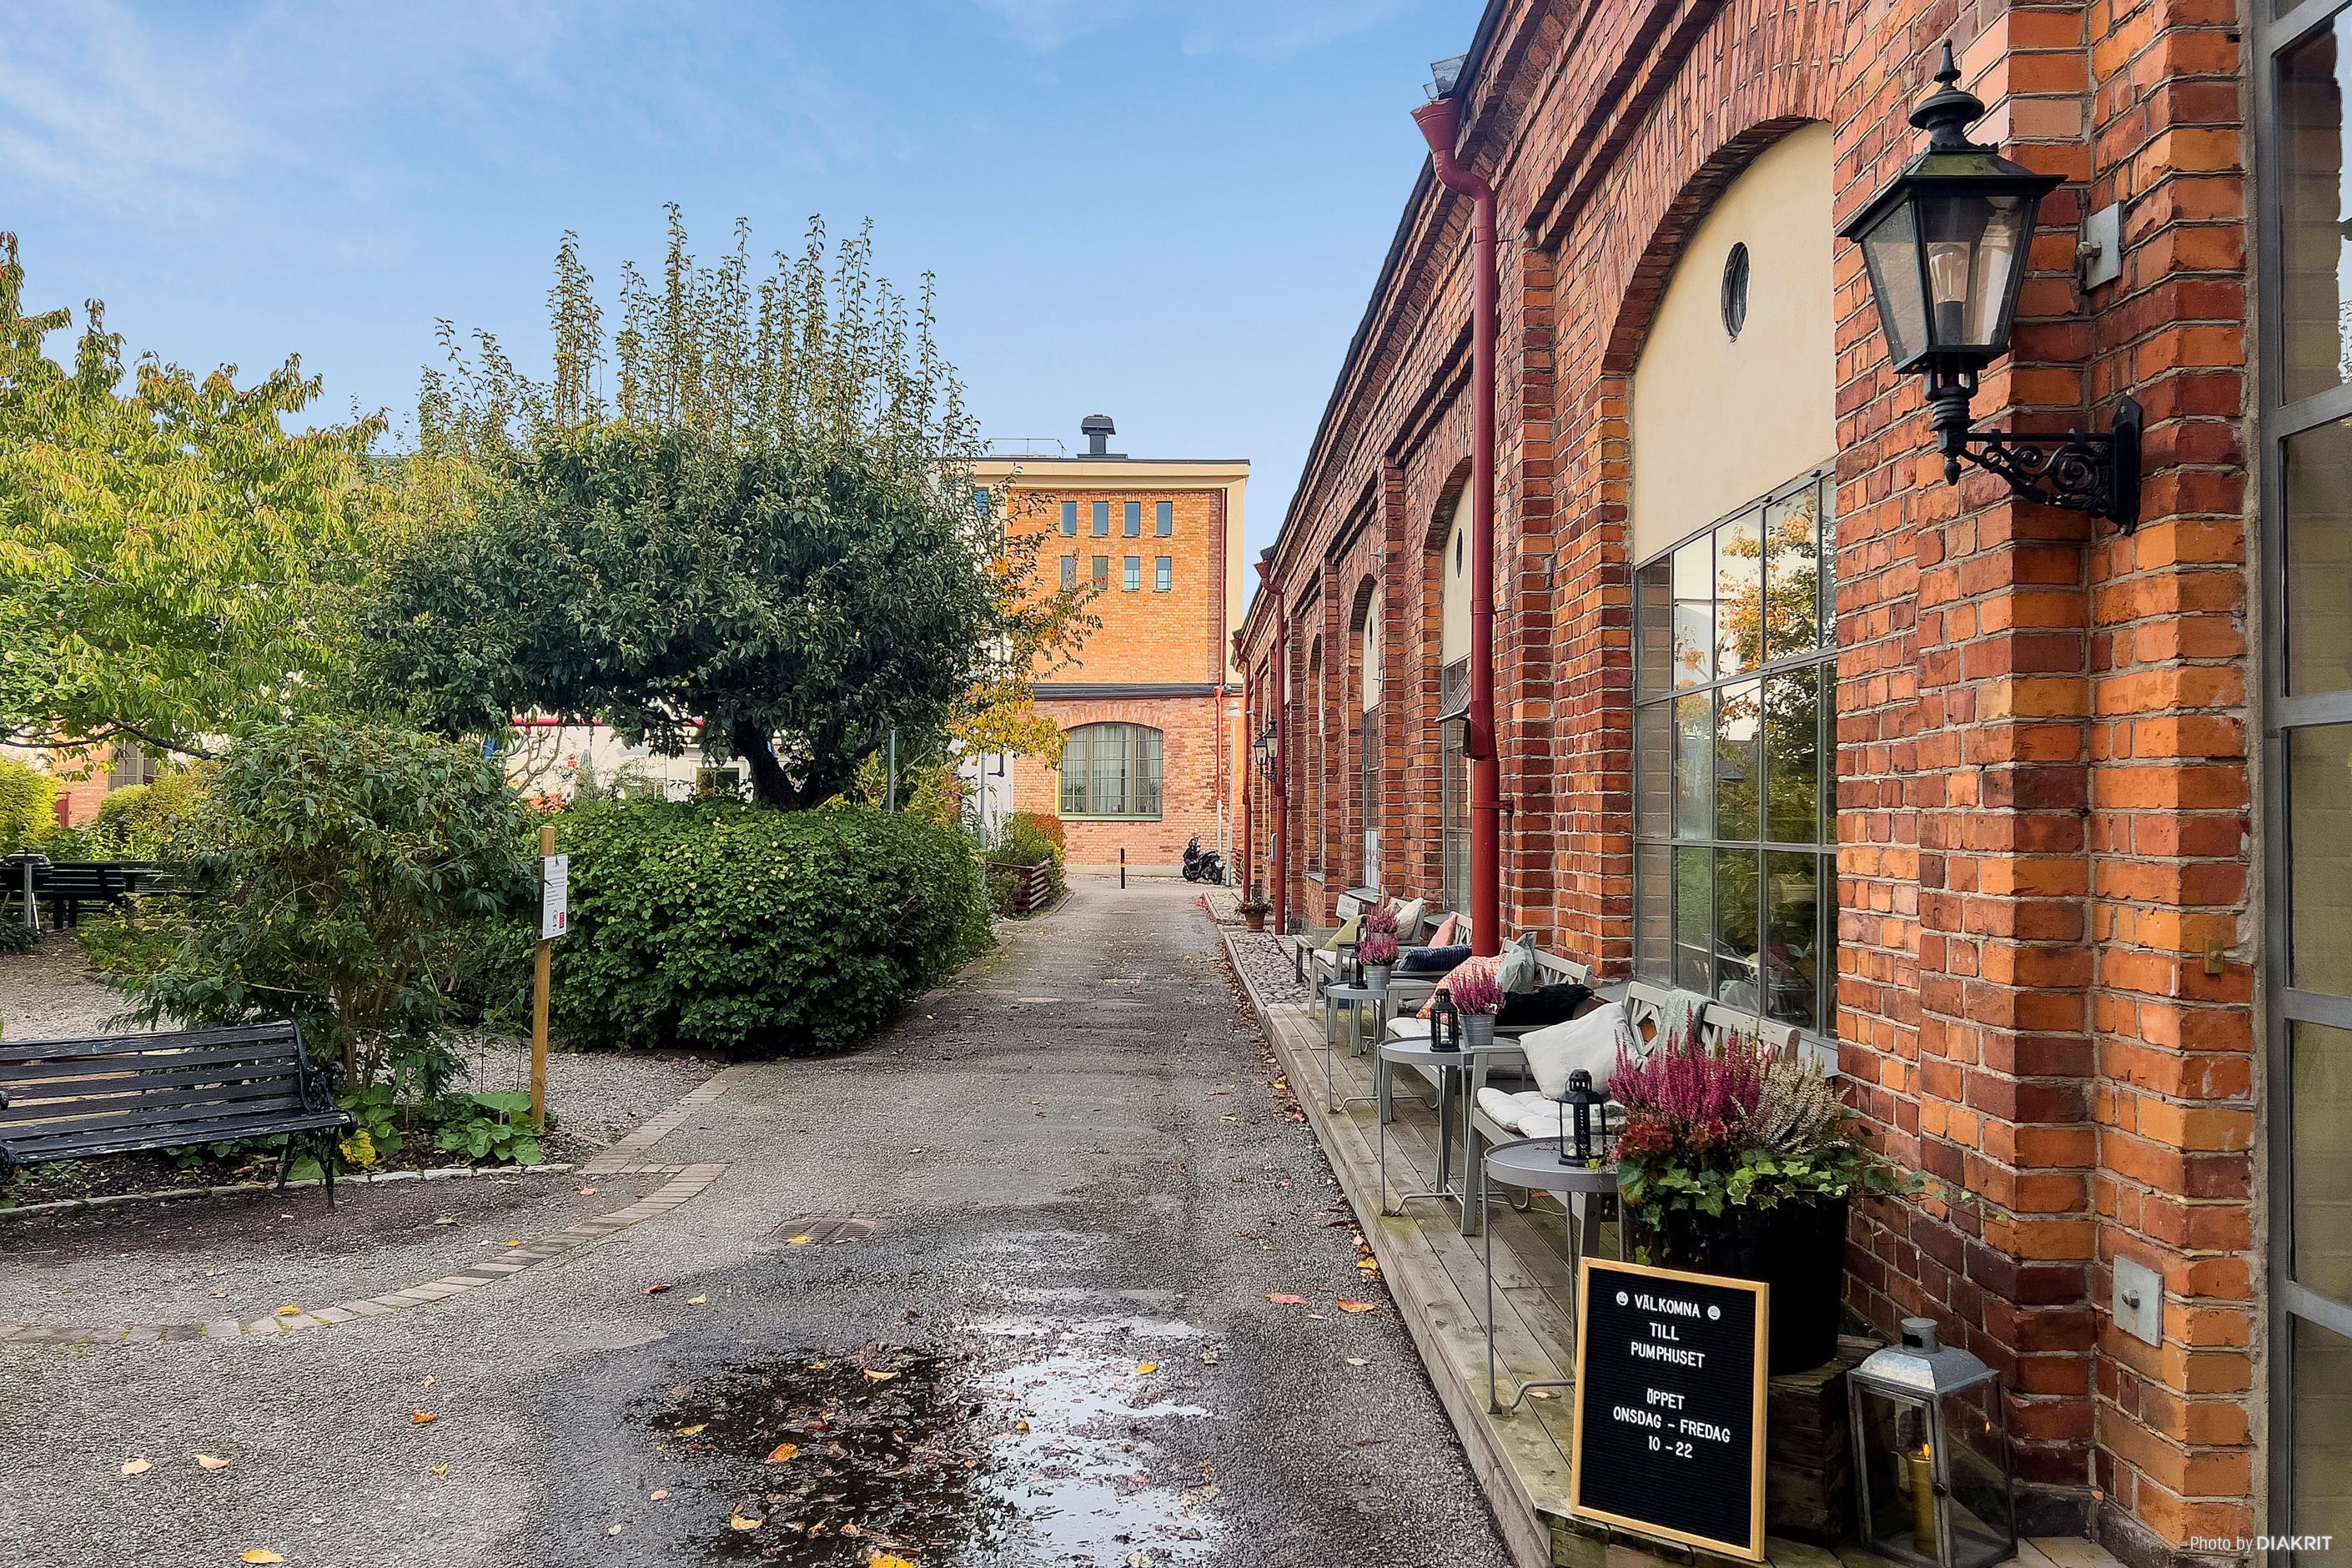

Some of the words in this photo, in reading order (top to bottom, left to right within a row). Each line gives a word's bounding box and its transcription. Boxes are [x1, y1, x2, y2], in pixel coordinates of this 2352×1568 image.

[1634, 1294, 1701, 1319] VÄLKOMNA
[1649, 1322, 1680, 1341] TILL
[1631, 1341, 1706, 1369] PUMPHUSET
[1646, 1387, 1686, 1410] ÖPPET
[1613, 1405, 1662, 1429] ONSDAG
[1680, 1418, 1731, 1443] FREDAG
[1648, 1435, 1661, 1451] 10
[1675, 1441, 1693, 1459] 22
